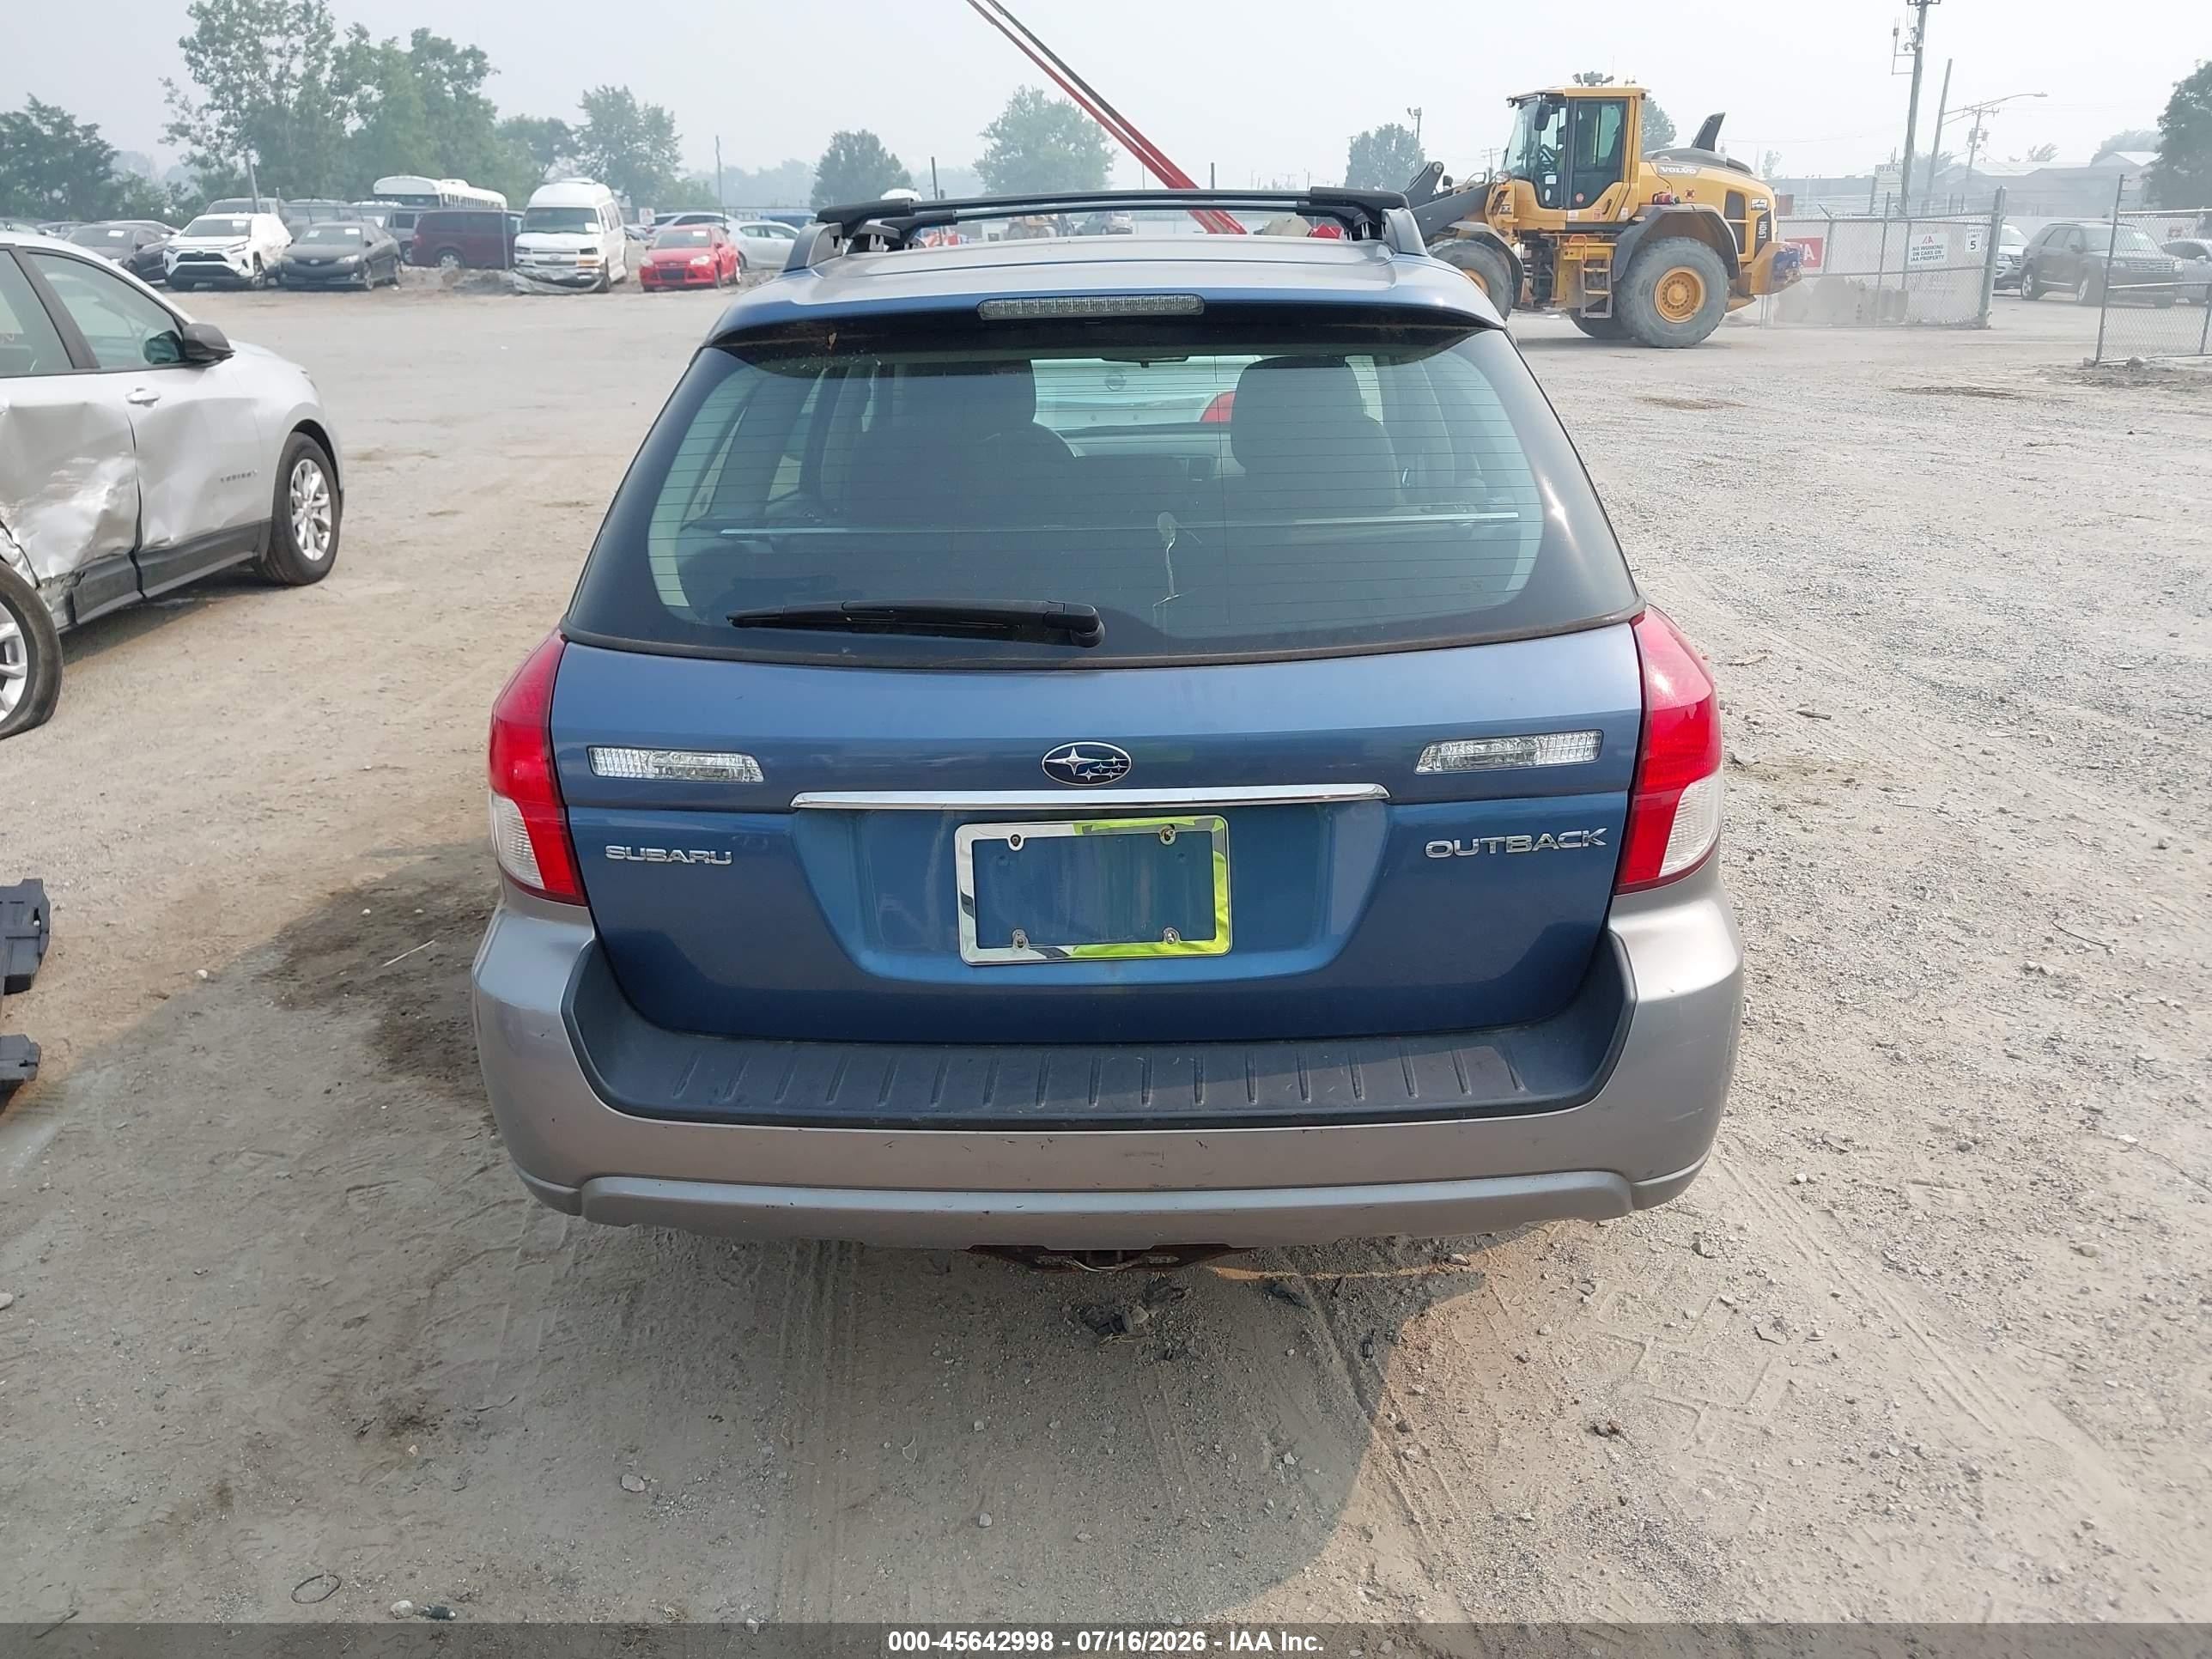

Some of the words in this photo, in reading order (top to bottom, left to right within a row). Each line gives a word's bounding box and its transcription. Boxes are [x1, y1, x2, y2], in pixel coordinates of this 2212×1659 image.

[1758, 221, 1768, 239] L90H
[1970, 240, 1977, 250] 5
[1425, 828, 1608, 859] OUTBACK
[605, 845, 732, 866] SUBARU
